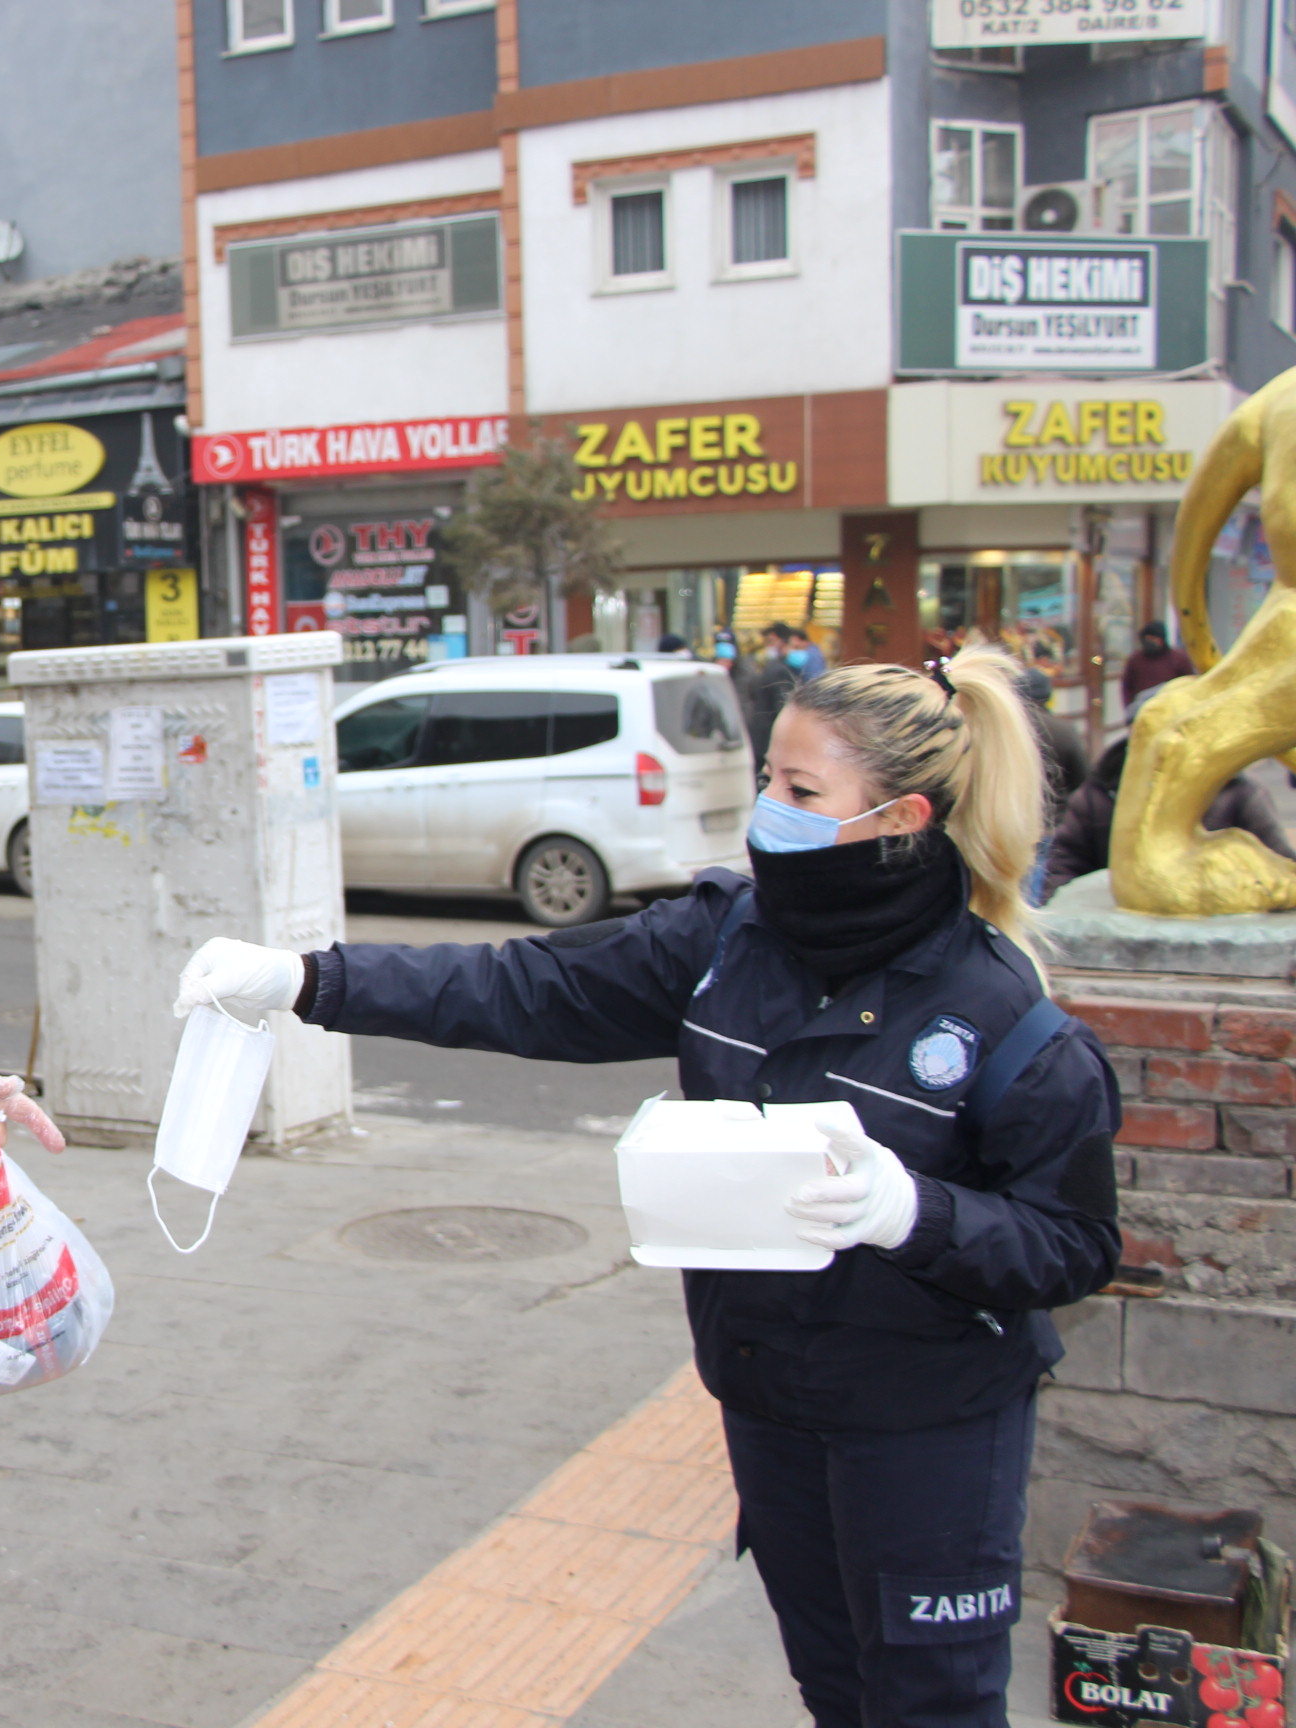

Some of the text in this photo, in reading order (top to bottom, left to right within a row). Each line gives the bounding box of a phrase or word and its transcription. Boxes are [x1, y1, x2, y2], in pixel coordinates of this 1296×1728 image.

[972, 313, 1038, 336] Dursun
[574, 413, 764, 468] ZAFER
[1005, 400, 1166, 448] ZAFER
[9, 431, 73, 456] EYFEL
[248, 430, 321, 471] TÜRK
[326, 427, 402, 465] HAVA
[5, 460, 83, 484] perfume
[571, 462, 797, 501] UYUMCUSU
[981, 451, 1194, 485] KUYUMCUSU
[0, 513, 94, 544] KALICI
[350, 517, 435, 551] THY
[160, 573, 182, 602] 3
[939, 1018, 976, 1043] ZABITA
[909, 1583, 1013, 1623] ZABITA
[1080, 1679, 1173, 1713] BOLAT
